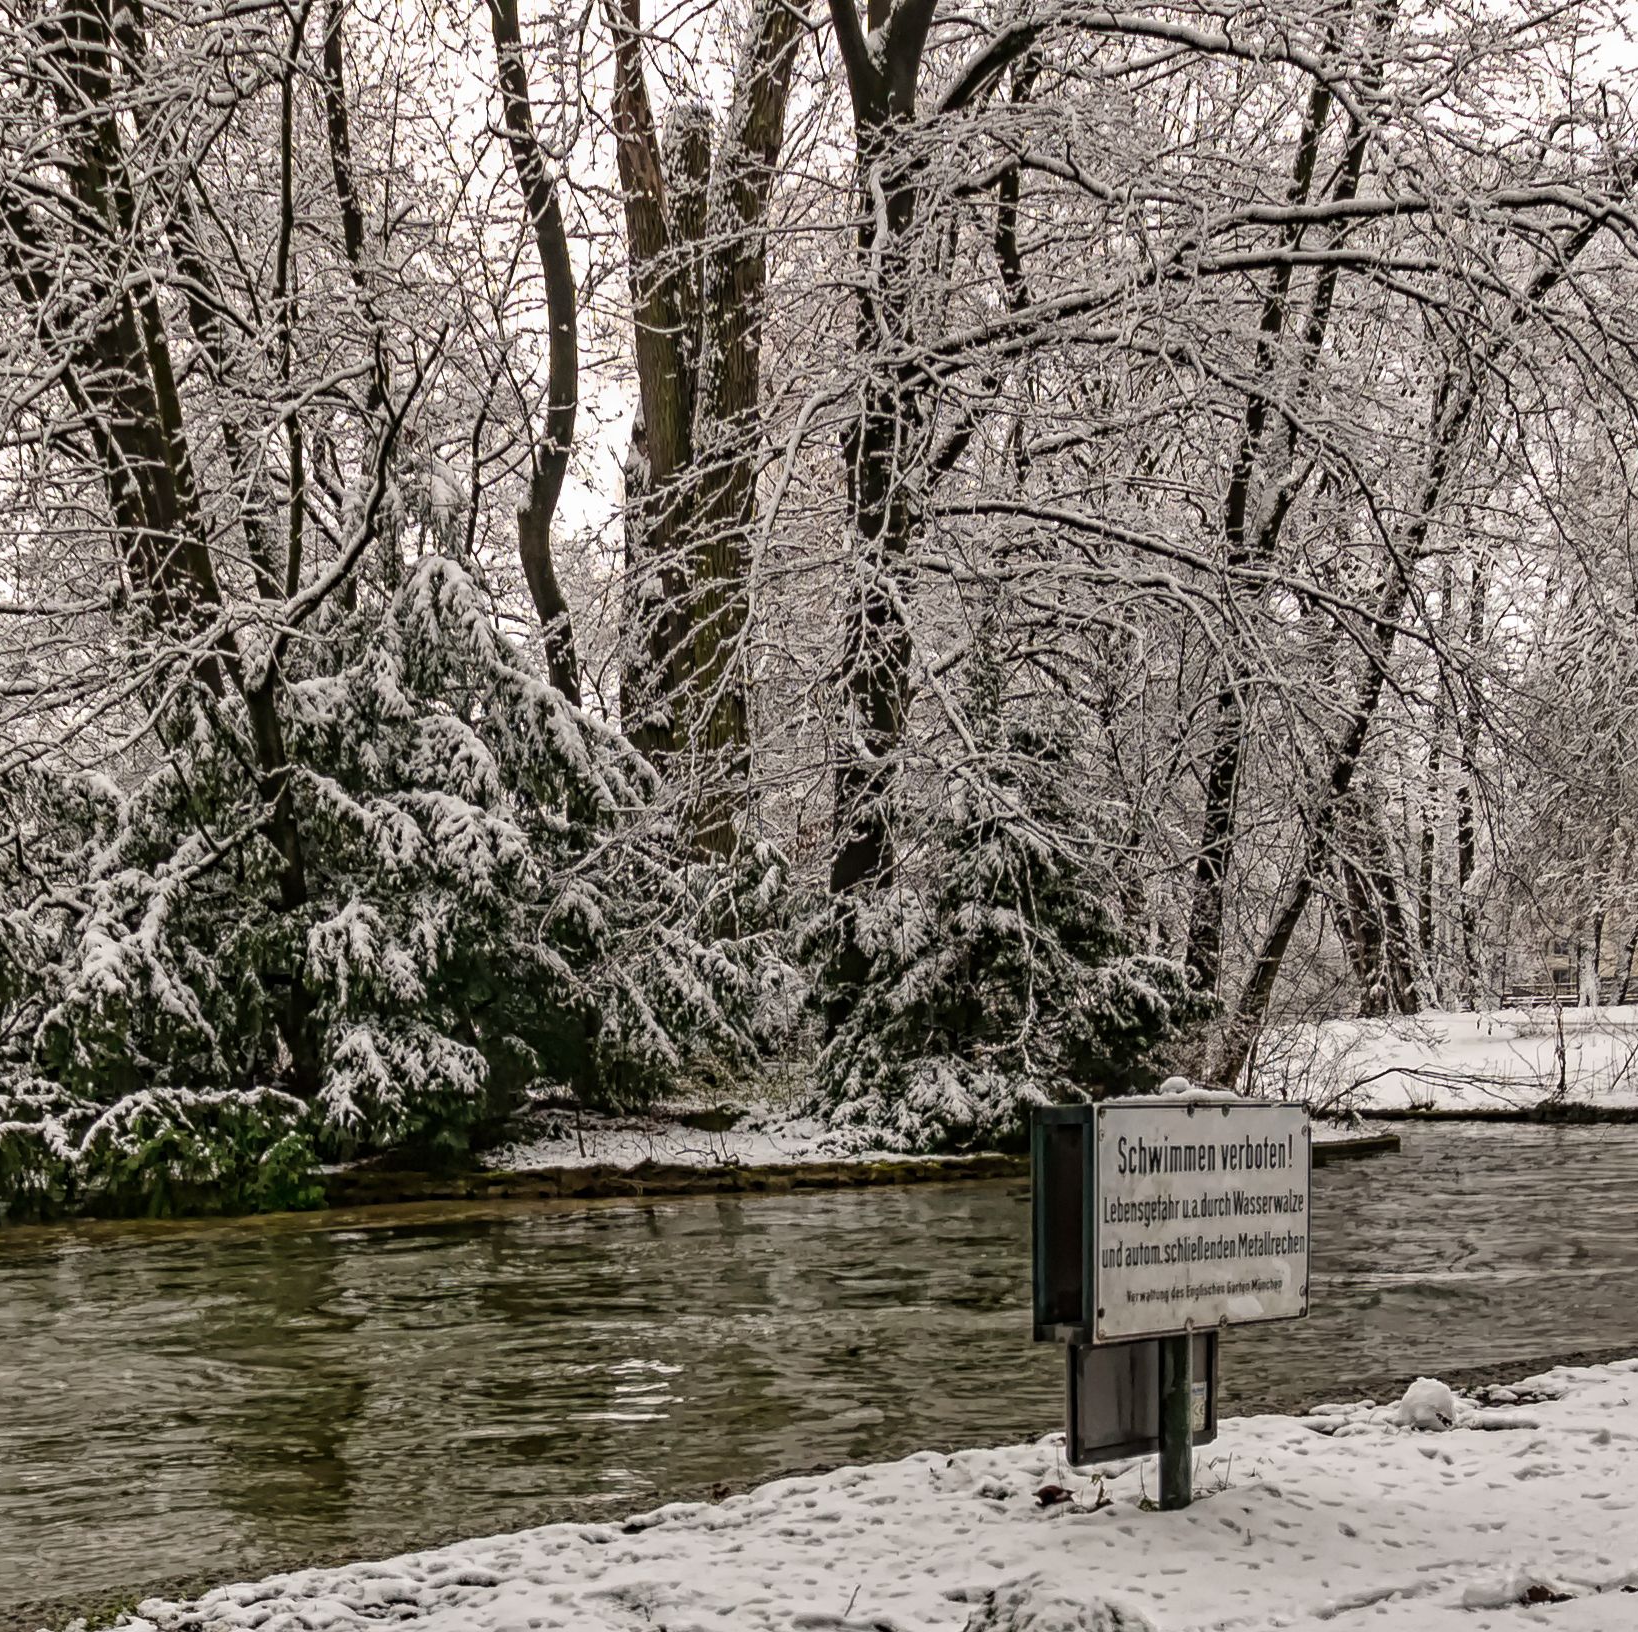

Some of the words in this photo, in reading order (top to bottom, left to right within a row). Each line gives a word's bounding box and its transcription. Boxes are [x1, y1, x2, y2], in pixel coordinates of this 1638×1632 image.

[1118, 1136, 1216, 1174] Schwimmen
[1220, 1134, 1293, 1170] verboten!
[1103, 1195, 1180, 1228] Lebensgefahr
[1233, 1188, 1304, 1215] Wasserwalze
[1102, 1241, 1123, 1269] und
[1125, 1243, 1164, 1267] autom.
[1164, 1235, 1236, 1263] schließenden
[1238, 1230, 1305, 1258] Metallrechen
[1126, 1289, 1169, 1304] Verwaltung
[1171, 1286, 1184, 1299] des
